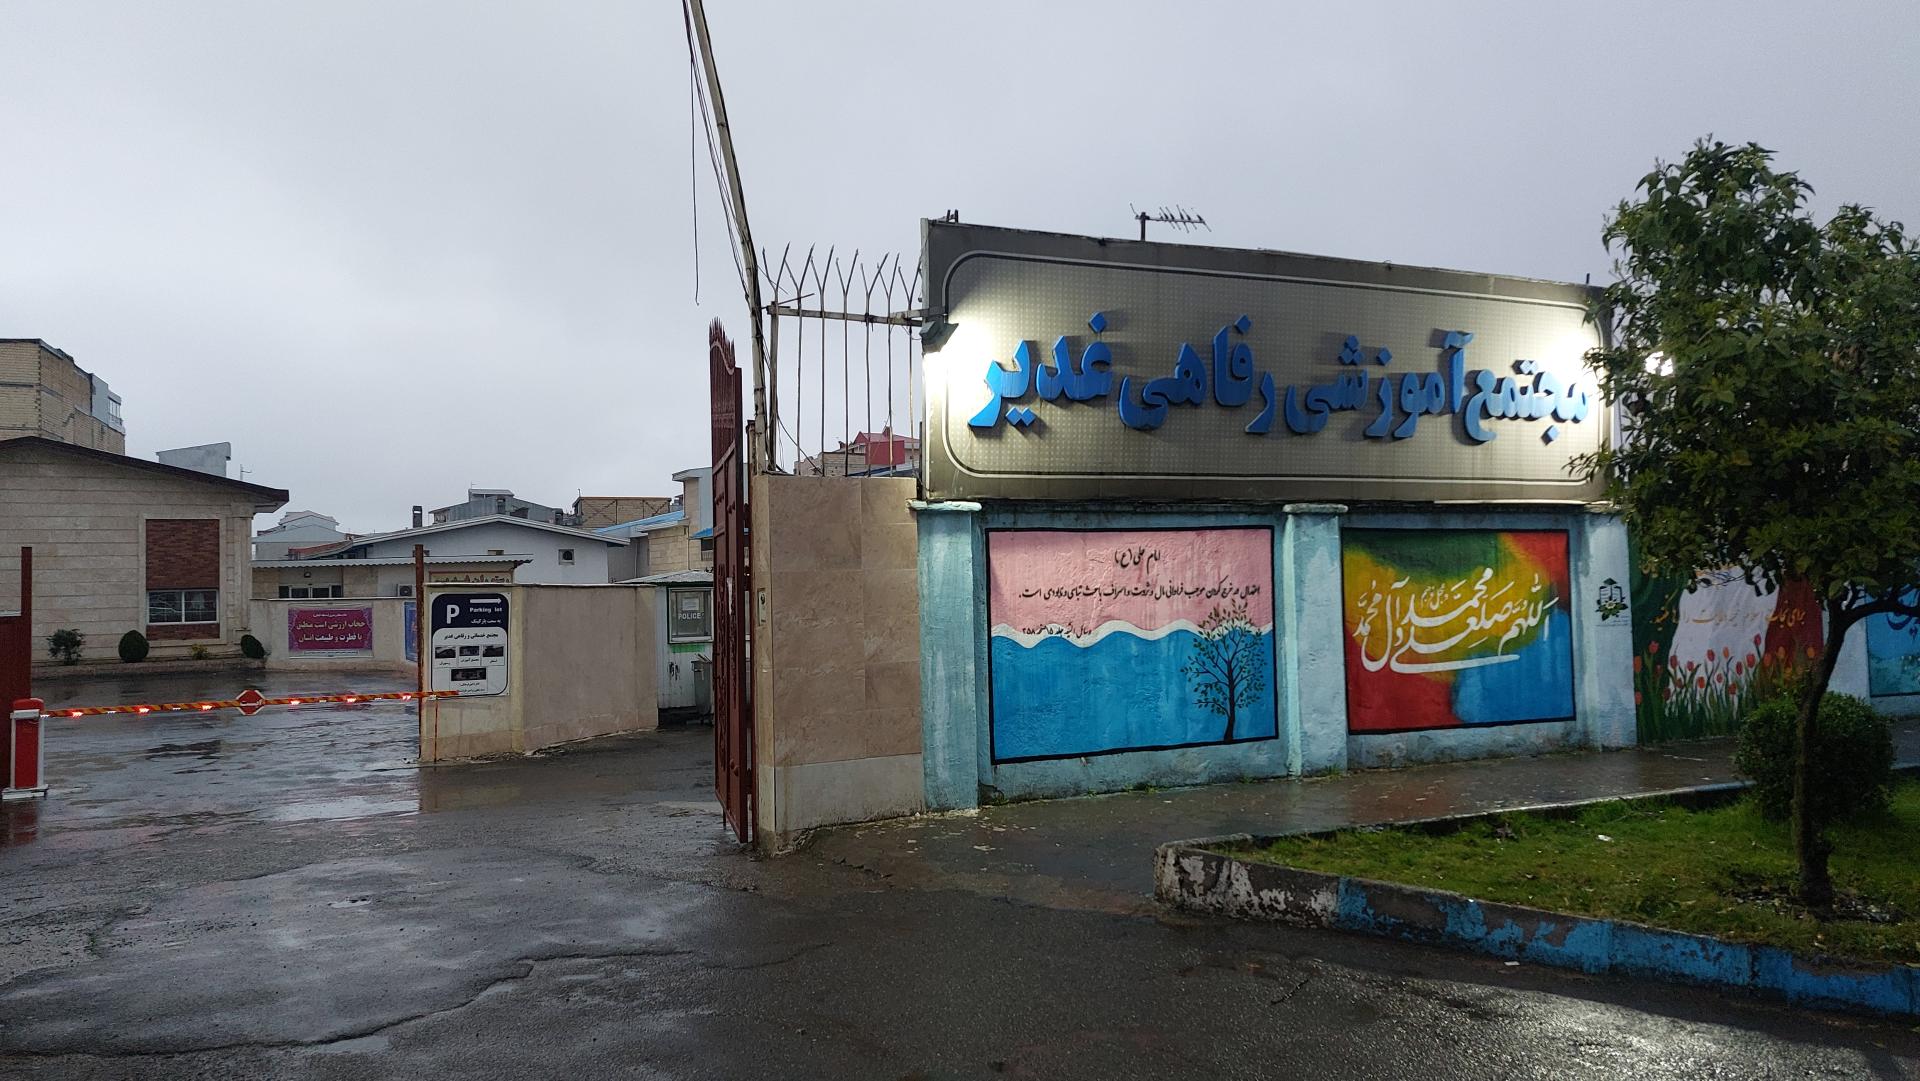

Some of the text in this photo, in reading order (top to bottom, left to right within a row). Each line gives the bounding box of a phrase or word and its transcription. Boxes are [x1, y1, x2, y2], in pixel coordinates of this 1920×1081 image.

[967, 311, 1588, 445] مجتمع آموزشی رفاهی غدیر
[446, 604, 460, 625] P
[678, 612, 701, 620] POLICE
